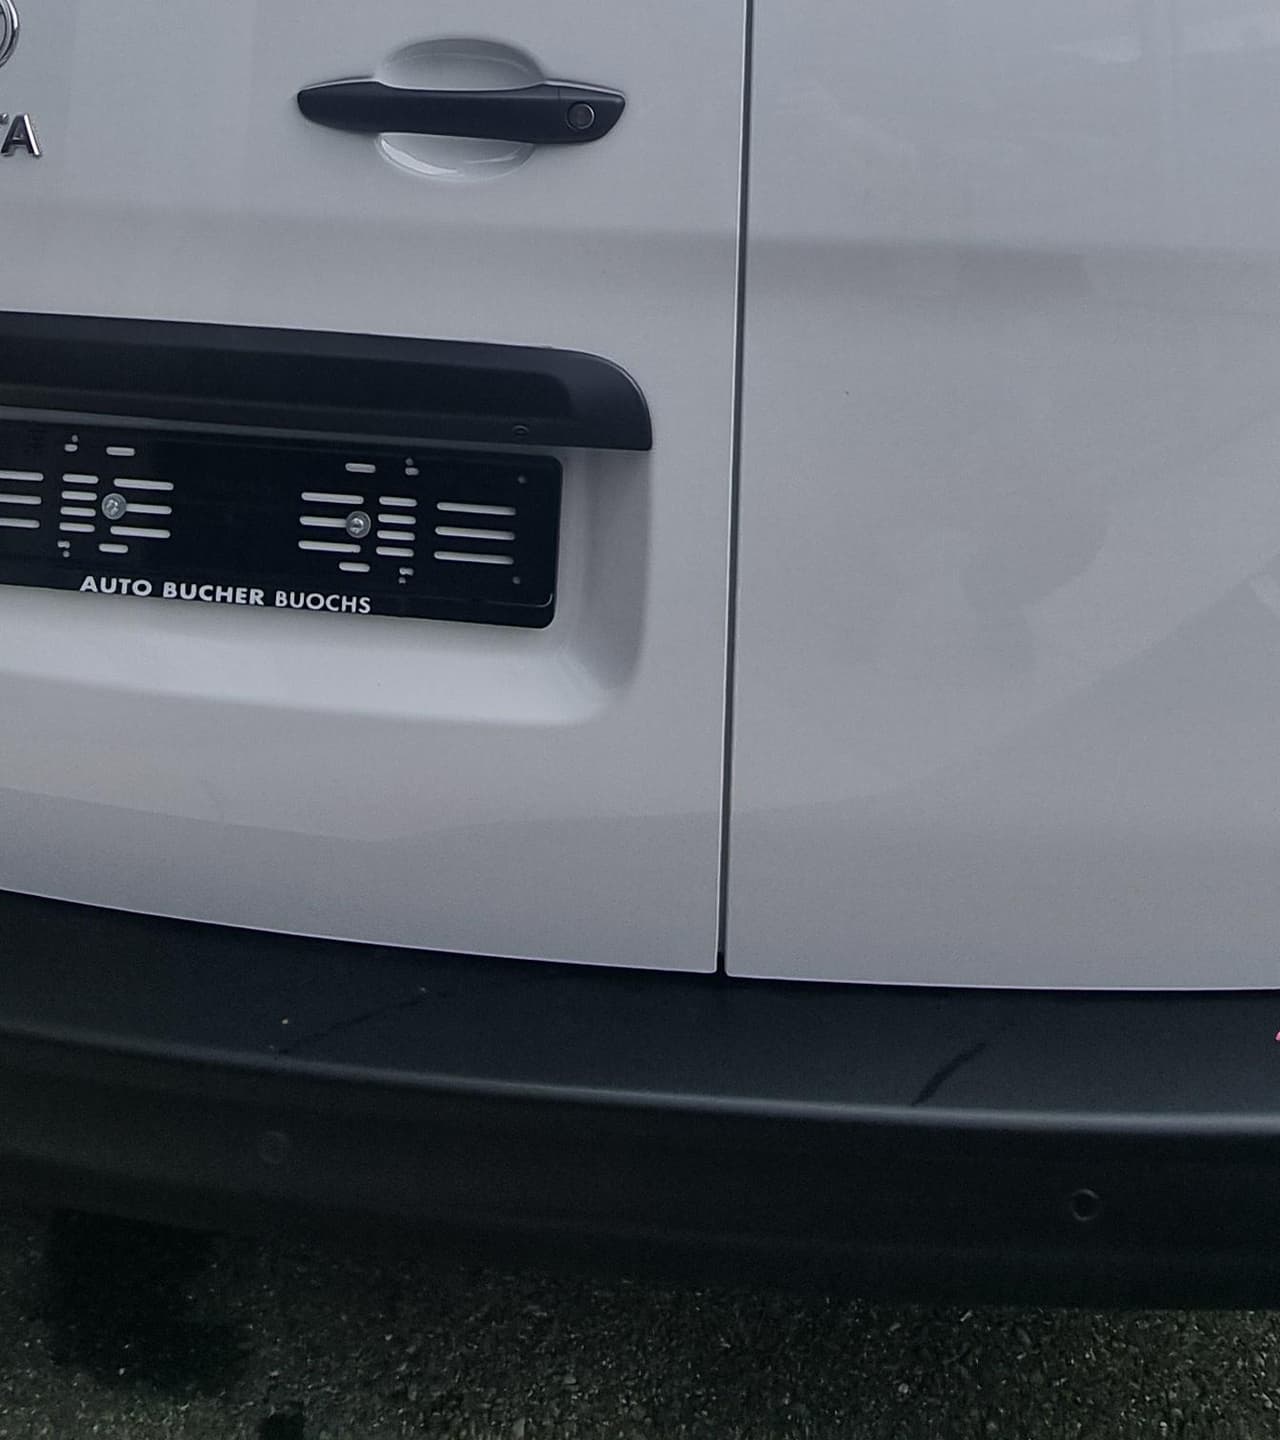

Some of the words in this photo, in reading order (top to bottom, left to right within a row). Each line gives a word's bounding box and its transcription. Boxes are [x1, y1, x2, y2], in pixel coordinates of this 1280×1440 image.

[80, 575, 153, 597] AUTO
[162, 581, 265, 606] BUCHER
[274, 590, 371, 614] BUOCHS
